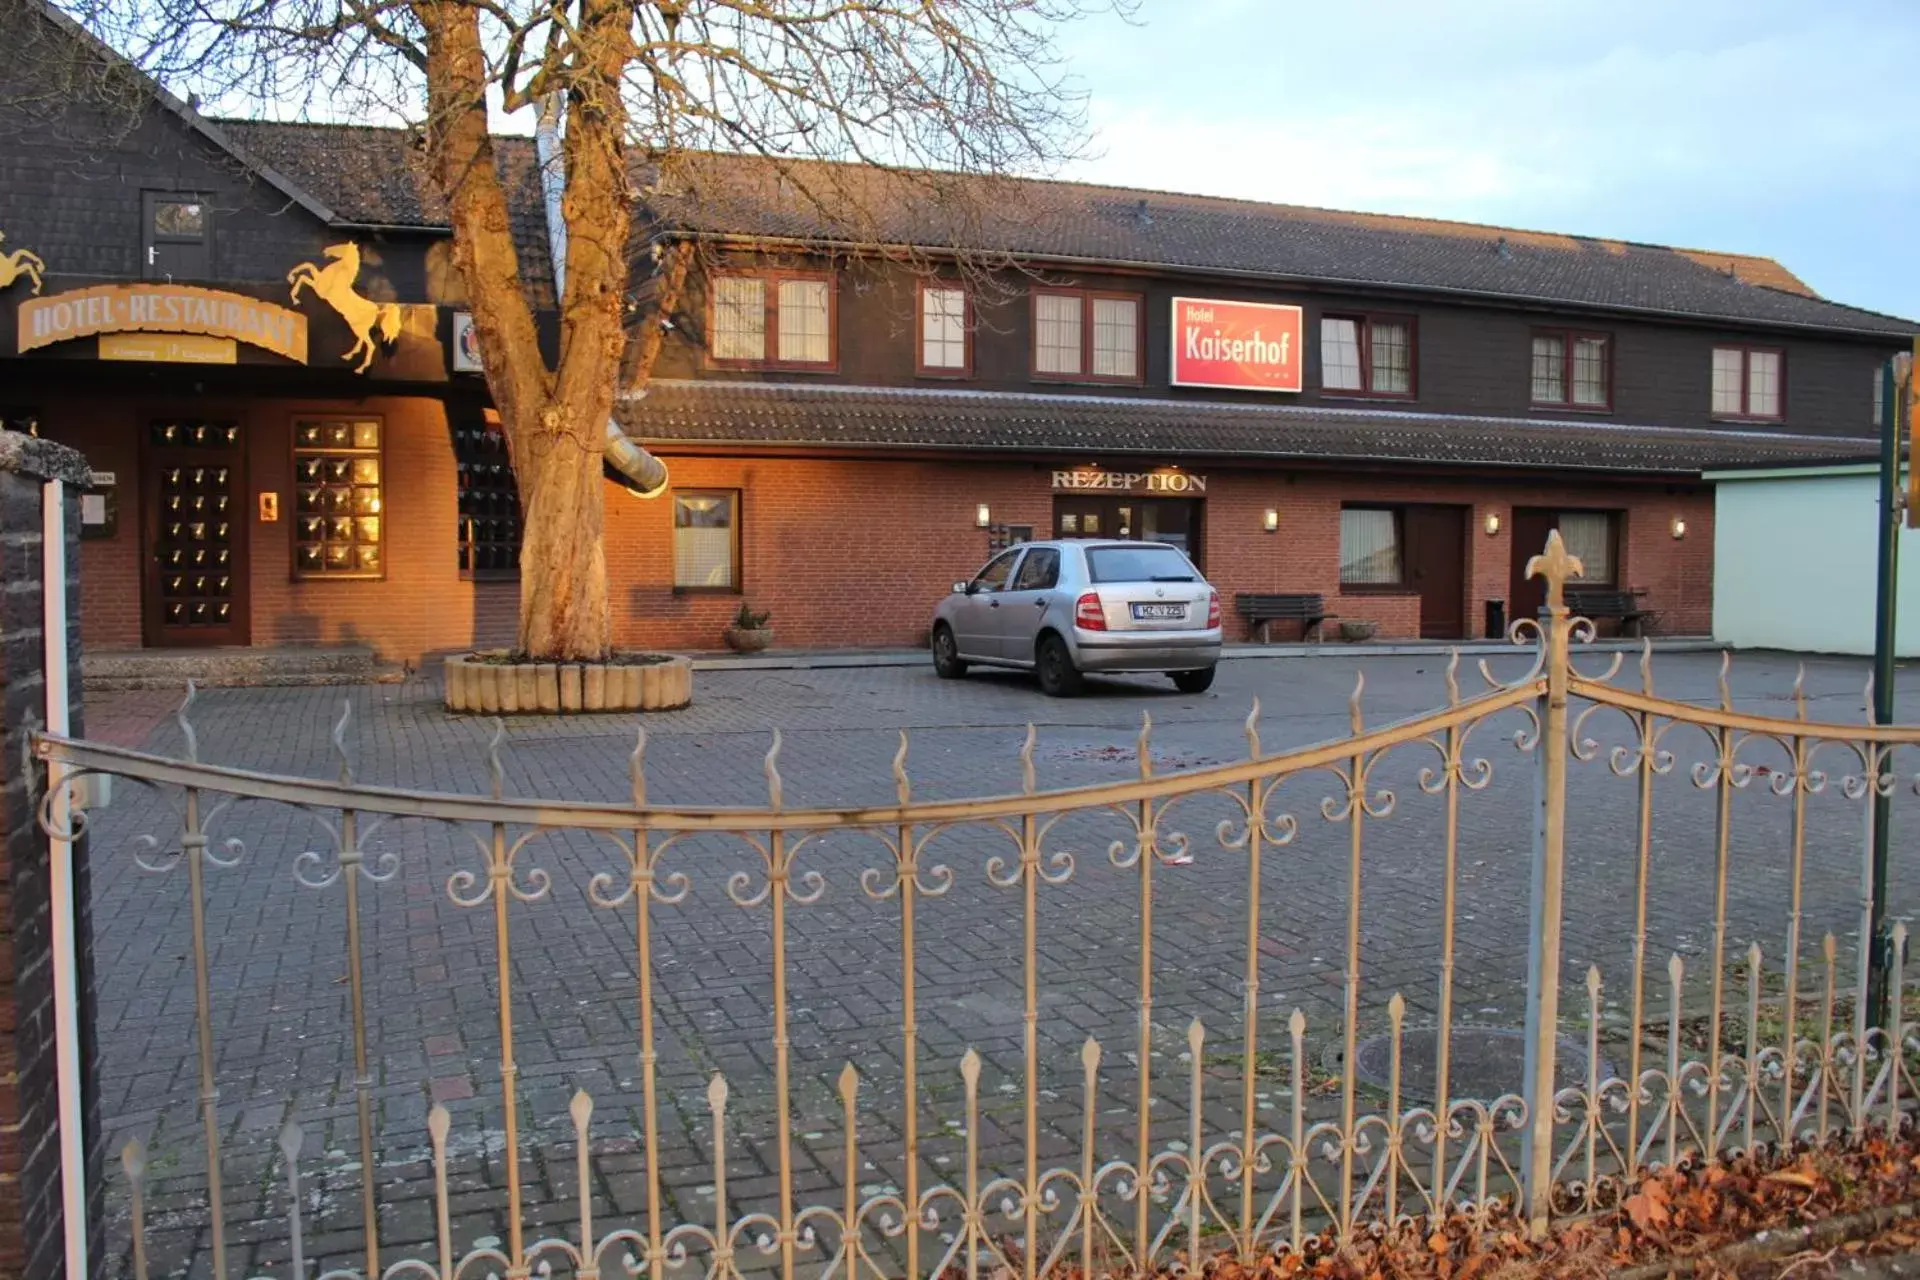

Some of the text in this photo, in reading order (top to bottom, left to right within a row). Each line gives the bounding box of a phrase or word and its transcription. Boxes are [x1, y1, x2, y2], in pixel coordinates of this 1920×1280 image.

[33, 294, 296, 349] HOTEL RESTAURANT
[1186, 305, 1214, 322] Hotel
[1185, 326, 1290, 365] Kaiserhof
[1051, 471, 1208, 492] REZEPTION
